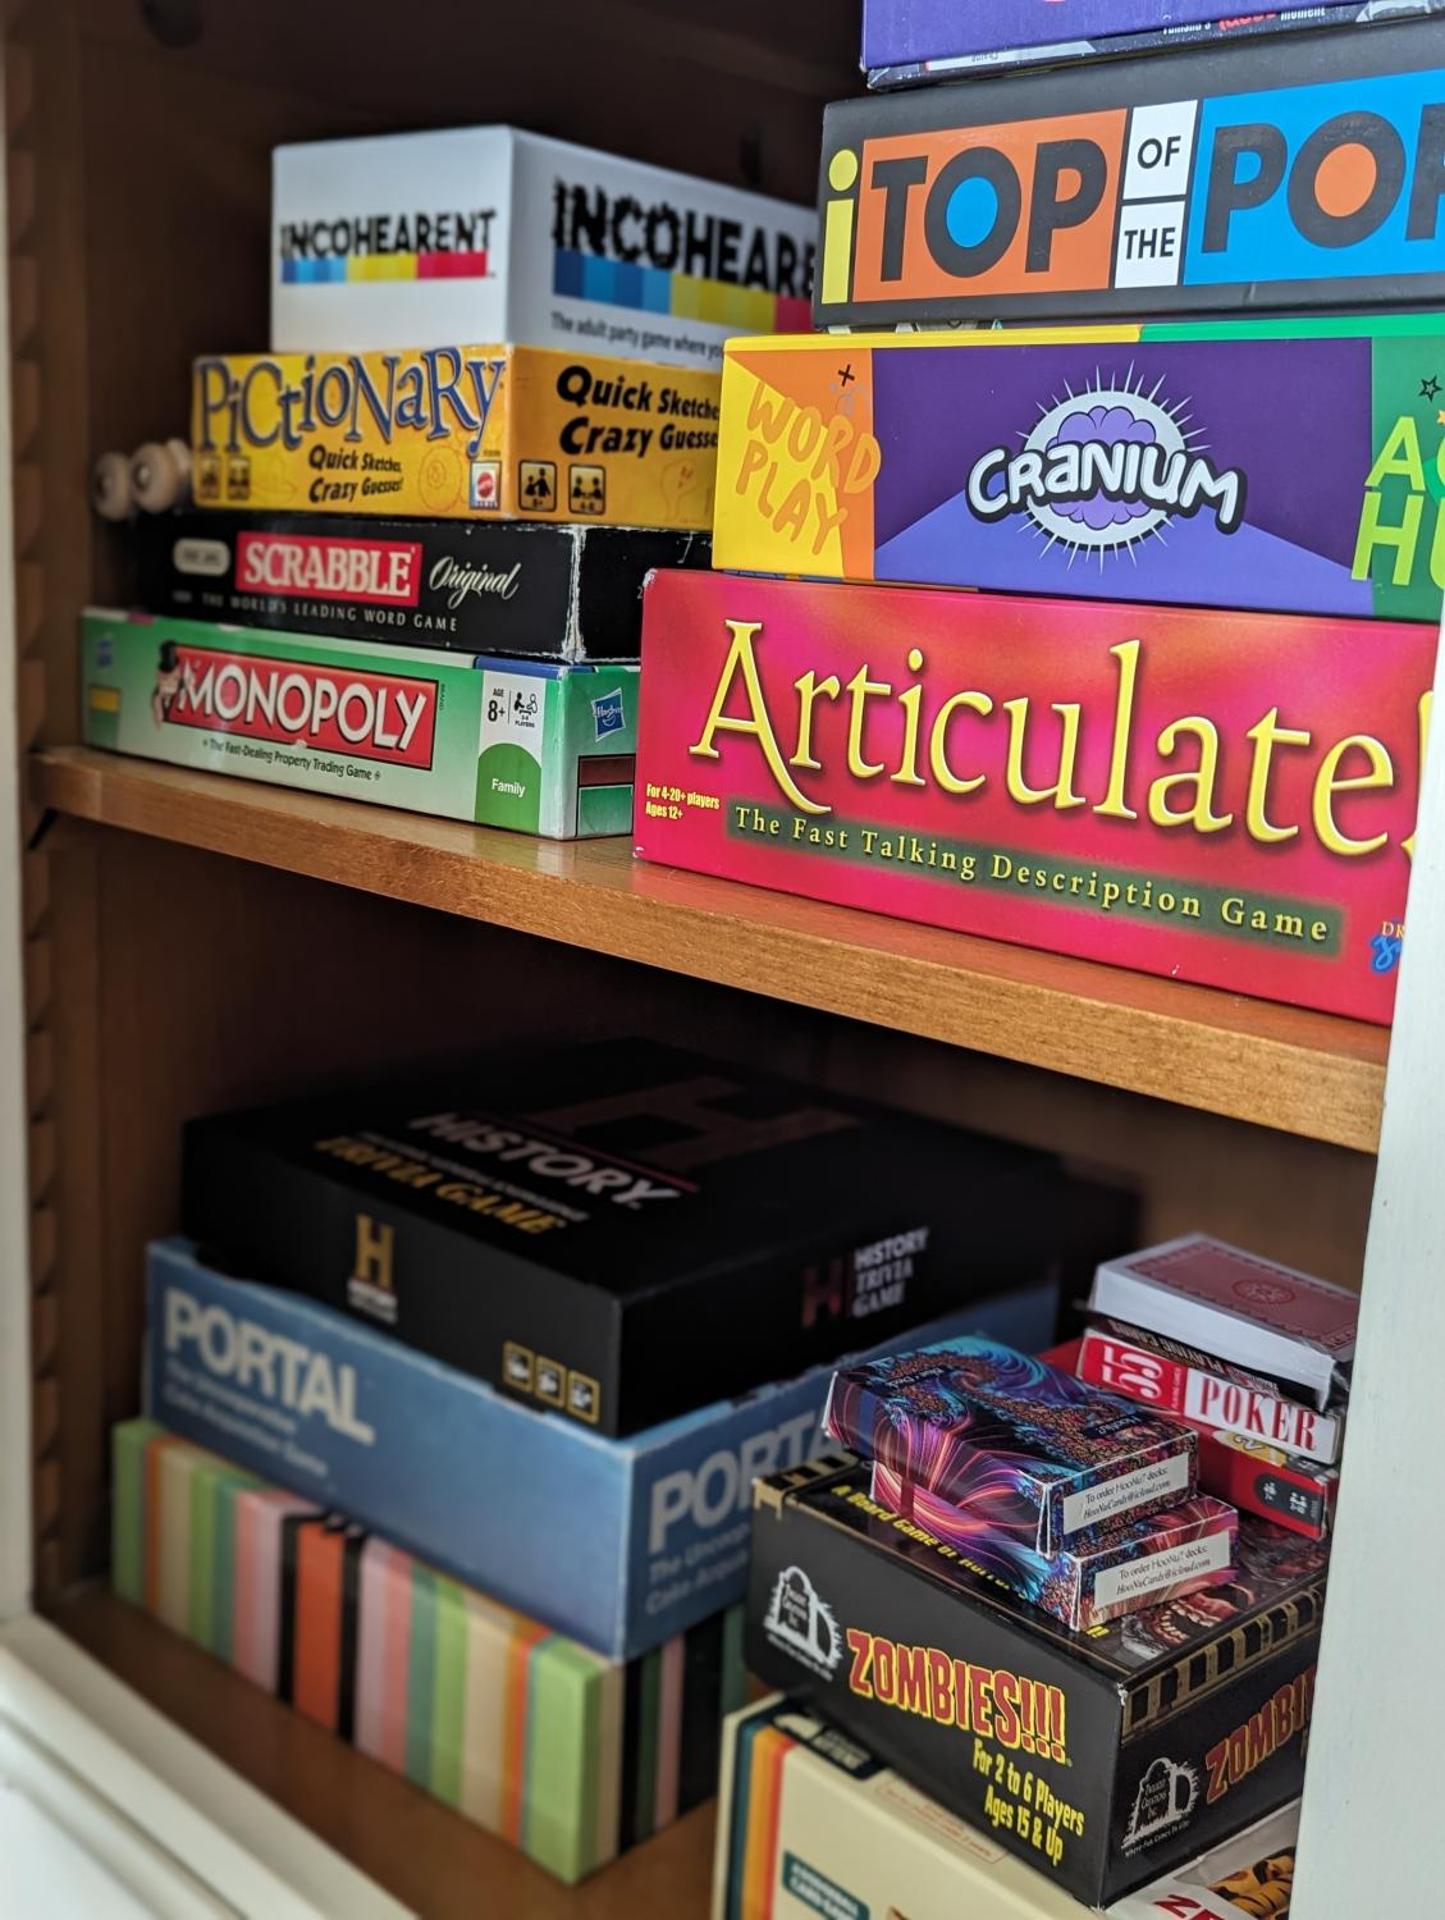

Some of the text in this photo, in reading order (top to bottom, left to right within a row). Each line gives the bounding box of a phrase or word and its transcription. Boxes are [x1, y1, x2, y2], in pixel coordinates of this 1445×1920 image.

[1137, 136, 1182, 169] OF
[871, 138, 1108, 281] TOP
[281, 209, 497, 259] INCOHEARENT
[1123, 227, 1175, 260] THE
[577, 316, 607, 338] adult
[609, 325, 639, 348] party
[641, 332, 672, 351] game
[673, 336, 706, 356] where
[556, 365, 653, 412] Quick
[308, 444, 358, 471] Quick
[559, 416, 654, 459] Crazy
[747, 382, 881, 494] WORD
[308, 478, 358, 503] Crazy
[736, 439, 848, 556] PLAY
[244, 542, 413, 597] SCRABBLE
[429, 556, 522, 610] Original
[230, 595, 288, 616] WORLD'S
[294, 602, 357, 622] LEADING
[364, 609, 406, 628] WORD
[414, 614, 458, 632] GAME
[177, 660, 427, 751] MONOPOLY
[487, 700, 506, 722] 8+
[492, 688, 504, 698] AGE
[225, 742, 273, 764] Fast-Dealing
[275, 749, 311, 770] Property
[313, 757, 344, 777] Trading
[346, 764, 373, 781] Game
[491, 778, 526, 798] Family
[646, 783, 720, 810] For 4-20+ players
[645, 801, 683, 820] Ages 12+
[735, 807, 1328, 941] The Fast Talking Description Game
[436, 1181, 560, 1234] GAME
[854, 1226, 929, 1270] HISTORY
[852, 1281, 904, 1318] GAME
[165, 1286, 377, 1447] PORTAL
[1199, 1376, 1318, 1451] POKER
[1084, 1492, 1096, 1505] To
[1096, 1484, 1116, 1501] order
[847, 1493, 897, 1521] Board
[894, 1513, 940, 1547] Game
[1118, 1568, 1130, 1580] To
[1129, 1561, 1154, 1577] order
[846, 1627, 1068, 1766] ZOMBIES!!!
[972, 1737, 993, 1776] For
[994, 1753, 1005, 1783] 2
[1007, 1762, 1020, 1796] to
[1023, 1771, 1034, 1803] 6
[1035, 1777, 1085, 1837] Players
[984, 1784, 1014, 1829] Ages
[1017, 1804, 1031, 1840] 15
[1032, 1816, 1044, 1850] &
[1045, 1824, 1064, 1867] Up
